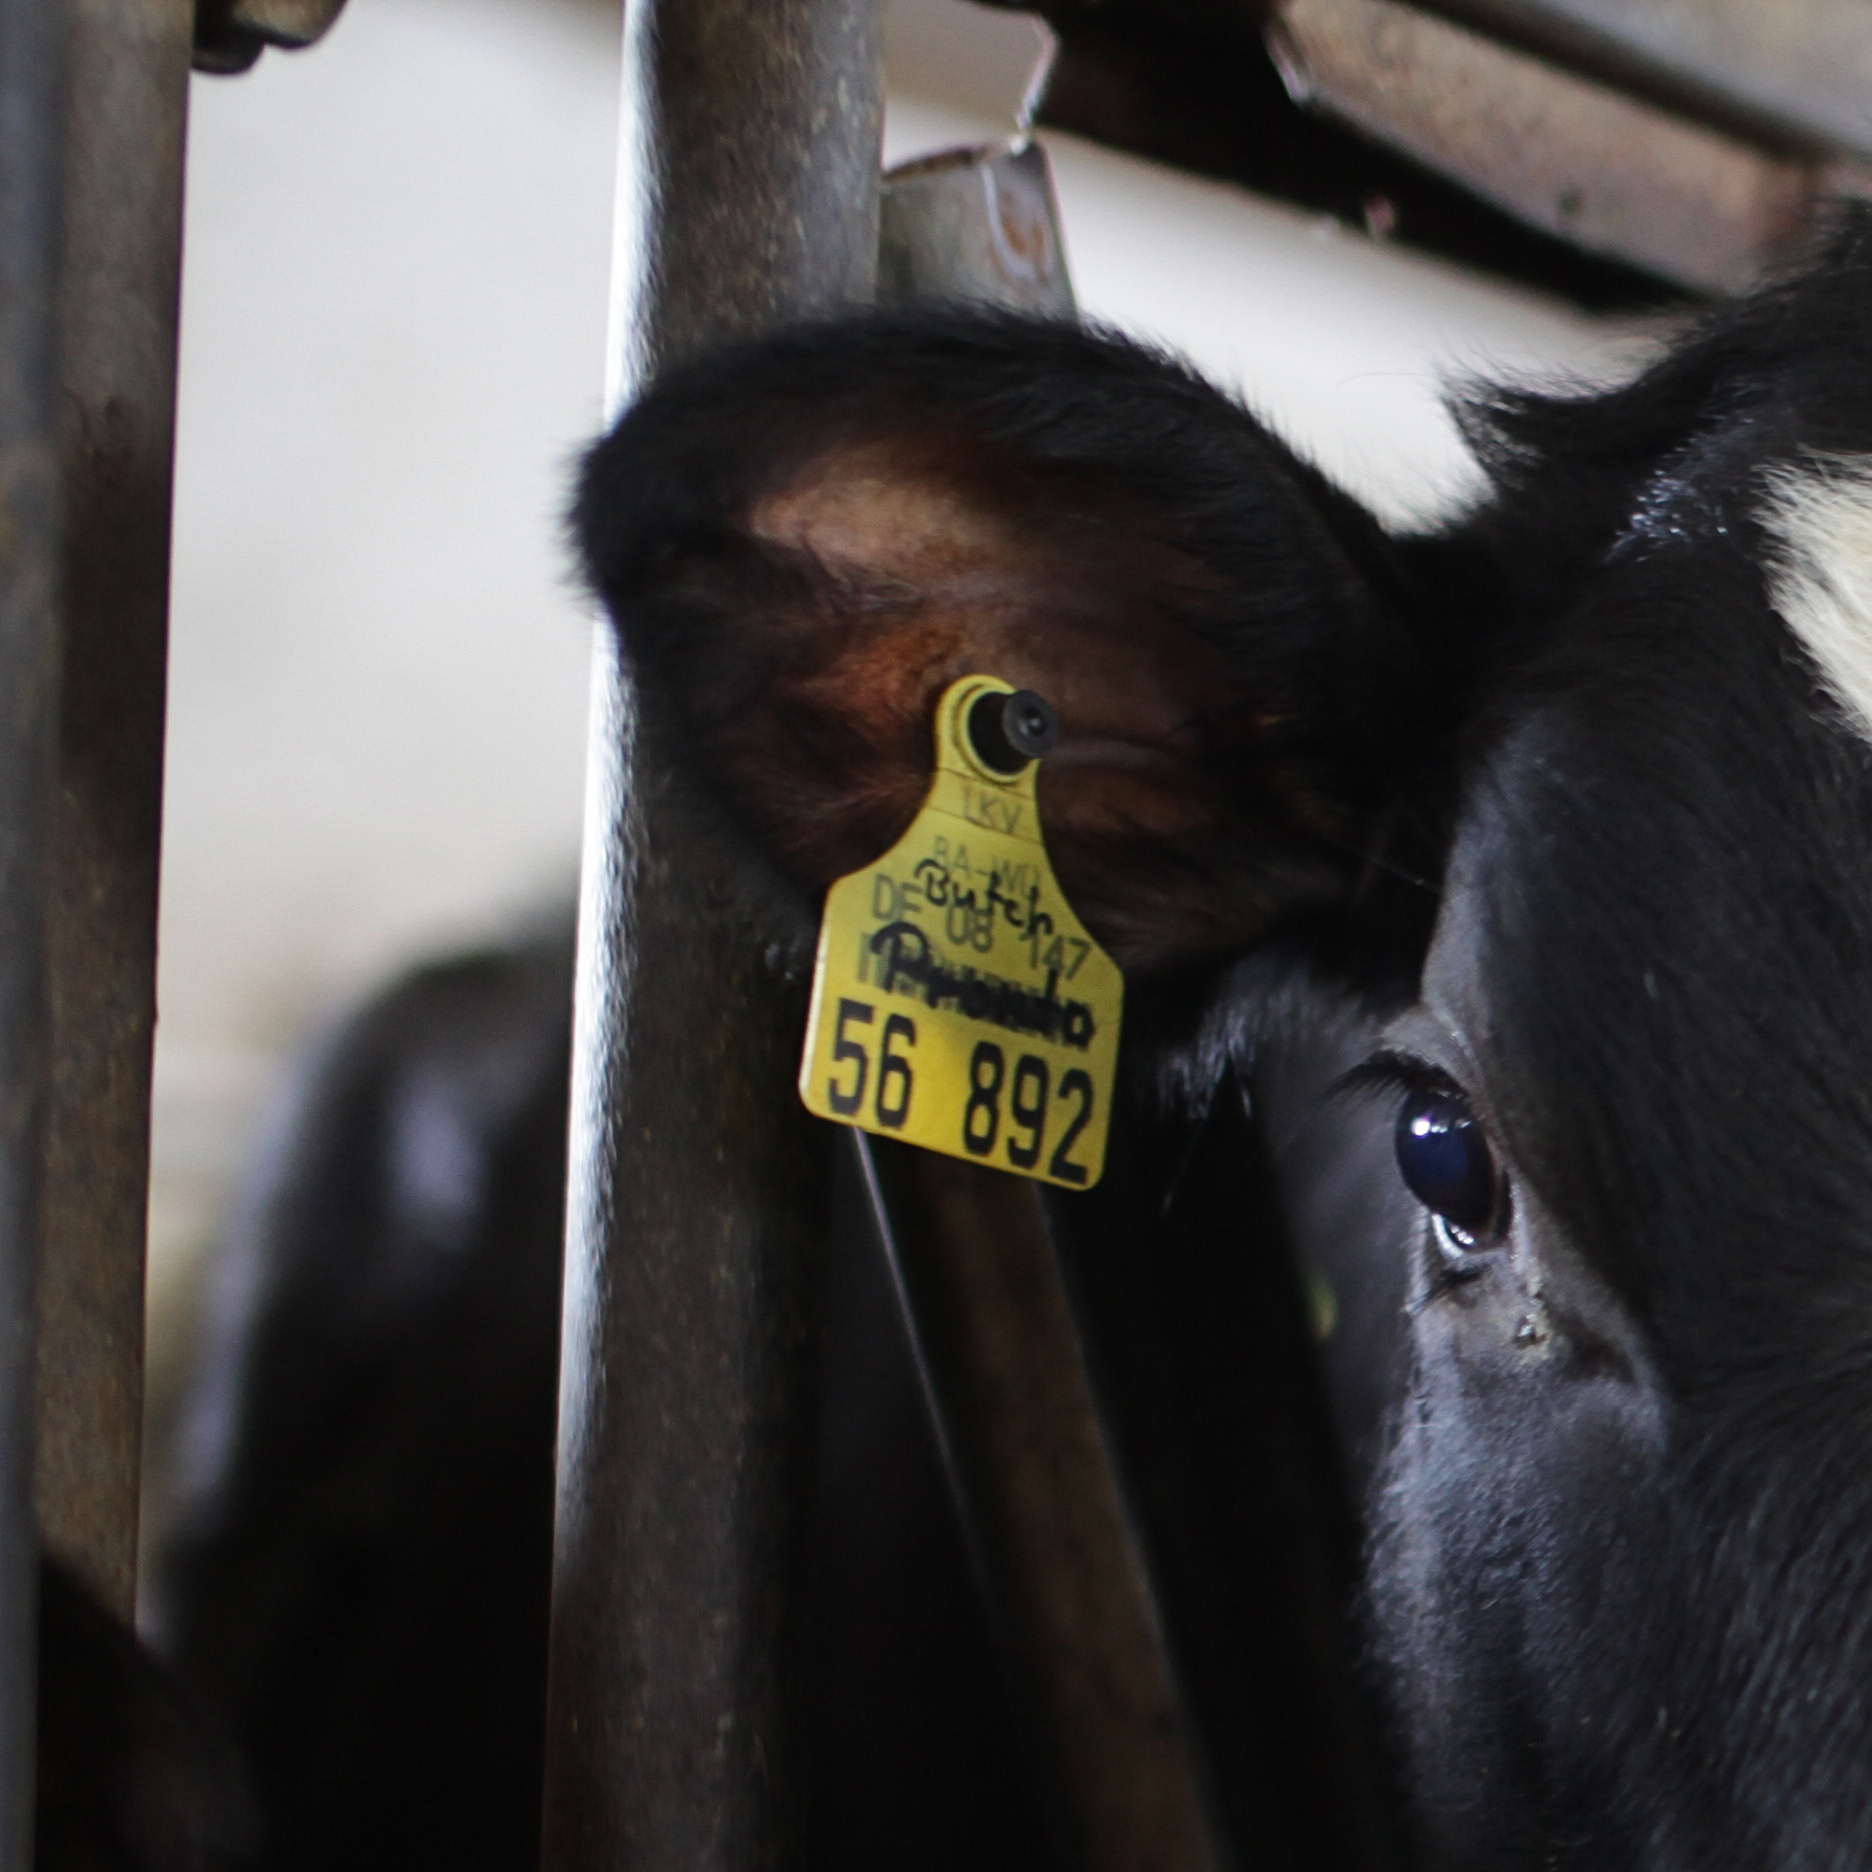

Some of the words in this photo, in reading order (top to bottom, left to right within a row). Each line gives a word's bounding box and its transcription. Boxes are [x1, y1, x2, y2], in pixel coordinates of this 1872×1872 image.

[963, 791, 1023, 834] LKV
[946, 902, 995, 954] 08
[827, 997, 917, 1128] 56
[963, 1041, 1096, 1185] 892
